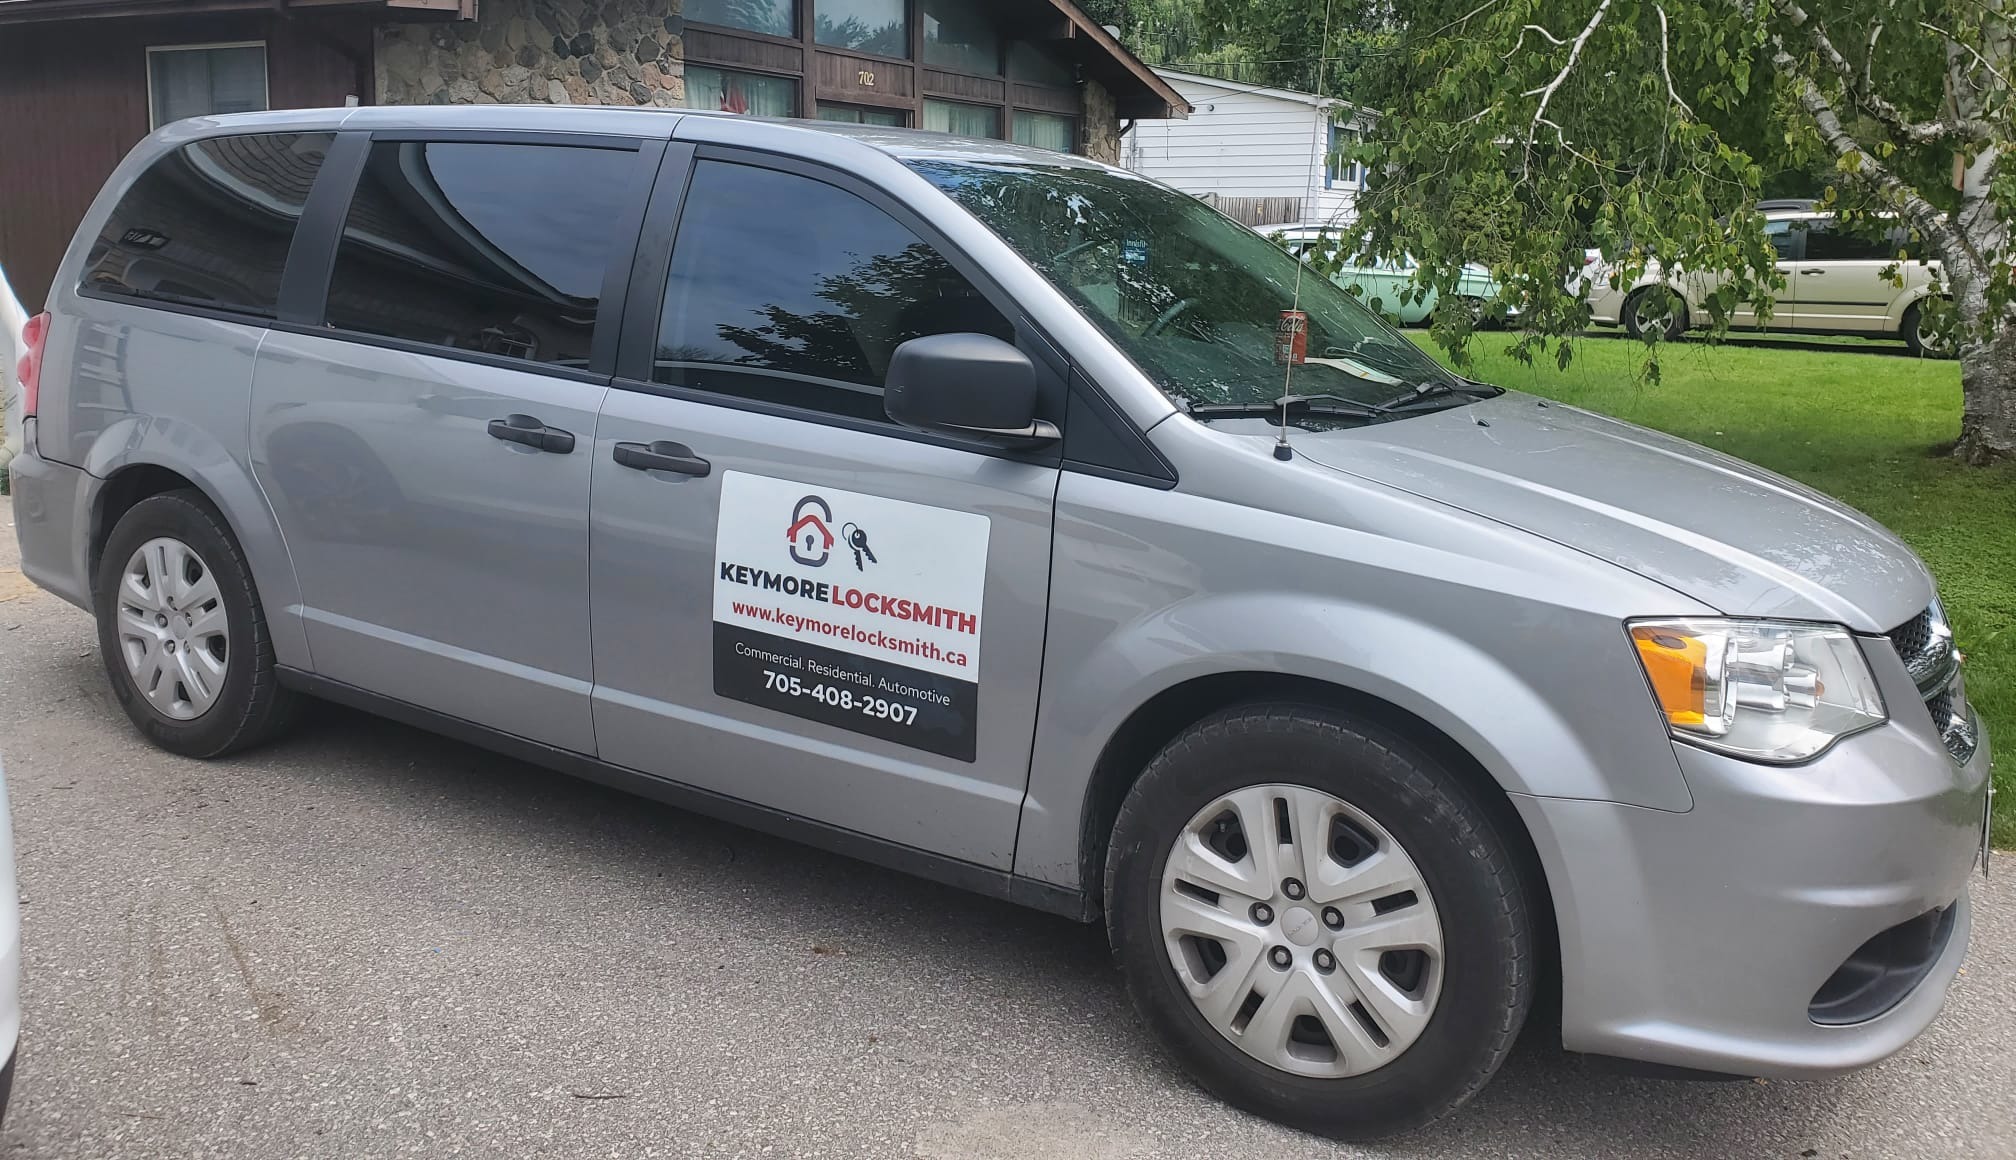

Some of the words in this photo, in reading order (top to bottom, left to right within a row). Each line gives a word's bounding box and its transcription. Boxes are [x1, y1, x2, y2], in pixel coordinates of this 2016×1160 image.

[858, 71, 875, 86] 702
[720, 561, 830, 603] KEYMORE
[832, 585, 977, 635] LOCKSMITH
[732, 601, 968, 667] www.keymorelocksmith.ca
[735, 642, 805, 671] Commercial.
[808, 659, 876, 689] Residential.
[878, 677, 951, 706] Automotive
[763, 670, 918, 726] 705-408-2907
